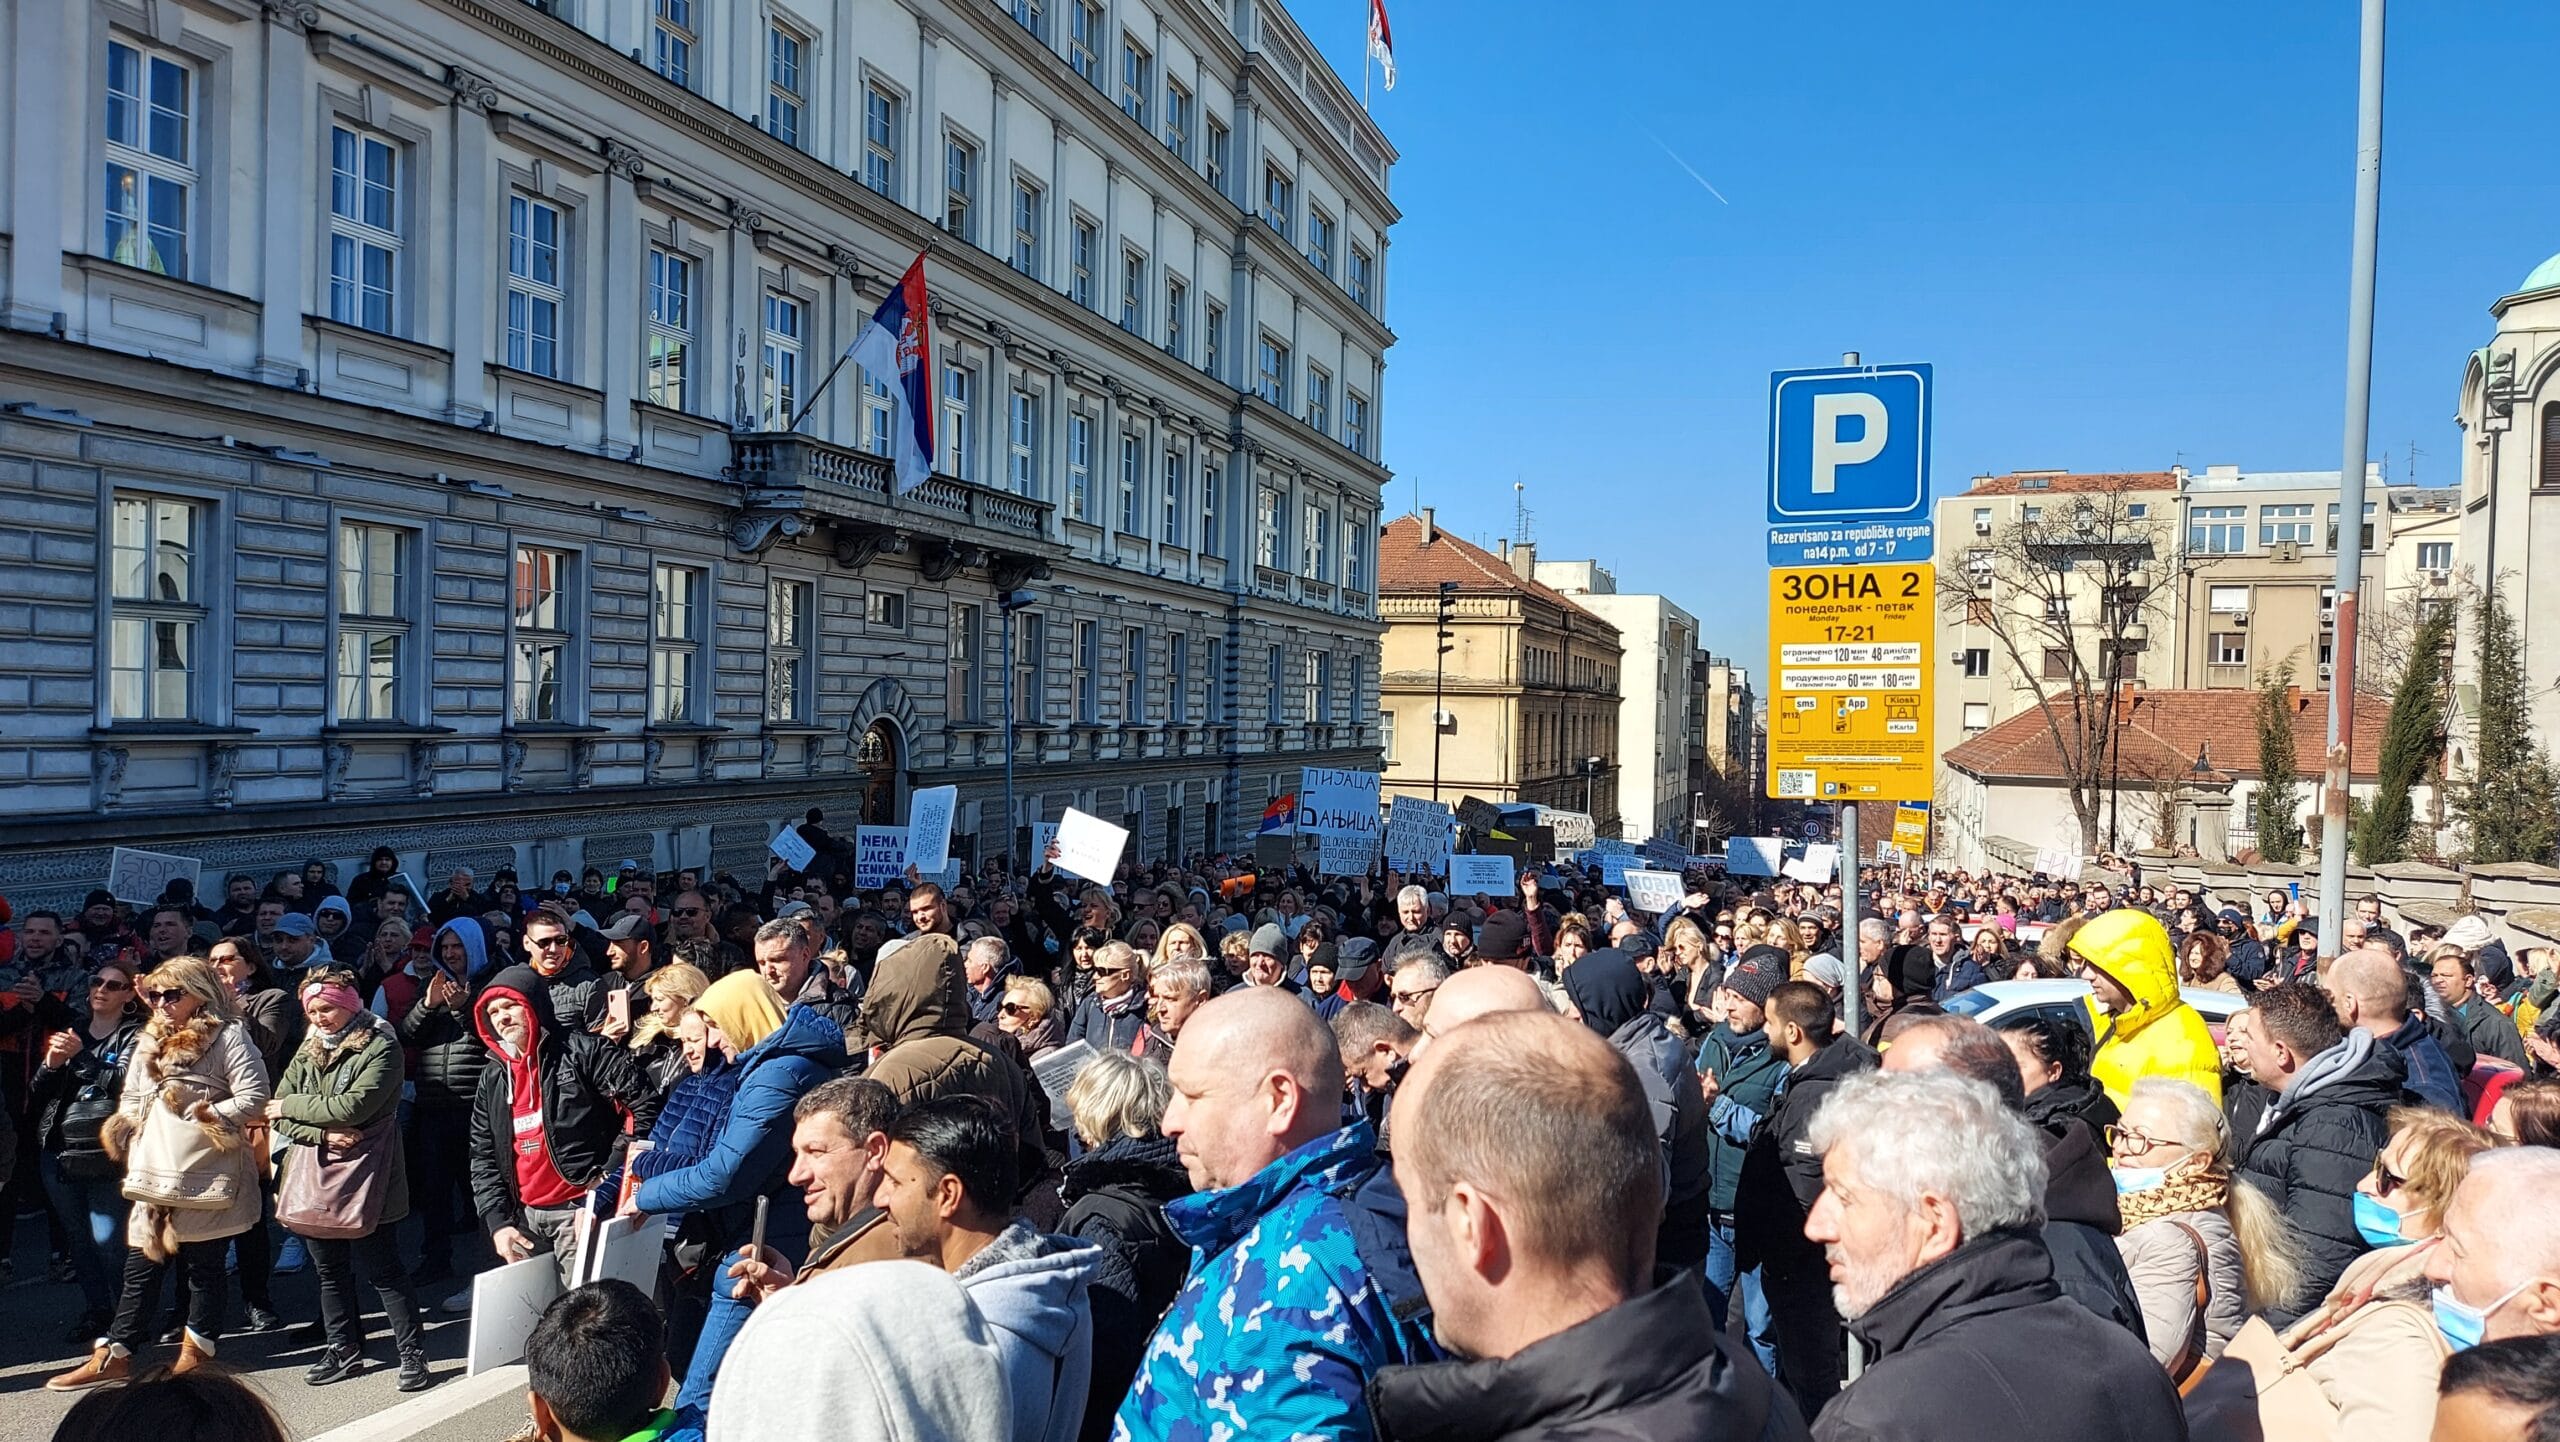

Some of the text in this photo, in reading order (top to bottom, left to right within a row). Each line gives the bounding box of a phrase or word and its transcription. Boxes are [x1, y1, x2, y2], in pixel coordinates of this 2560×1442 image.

[1811, 392, 1889, 494] P
[1771, 525, 1930, 544] Rezervisano za republičke organe
[1830, 547, 1850, 561] p.m.
[1855, 542, 1868, 557] od
[1869, 542, 1877, 556] 7
[1885, 541, 1897, 555] 17
[1782, 572, 1920, 601] ЗОНА 2
[1786, 604, 1863, 615] понедељак
[1875, 603, 1914, 613] петак
[1809, 614, 1840, 622] Monday
[1884, 613, 1906, 621] Friday
[1824, 625, 1875, 641] 17-21
[1783, 649, 1833, 657] ограничено
[1834, 647, 1850, 662] 120
[1871, 647, 1882, 661] 48
[1883, 647, 1917, 655] дин/сат
[1786, 675, 1835, 683] продужено
[1847, 673, 1859, 688] 60
[1881, 673, 1897, 688] 180
[1797, 700, 1815, 708] sms
[1848, 698, 1866, 709] App
[1890, 696, 1915, 704] Kiosk
[1307, 769, 1377, 791] ПИЈАЦА
[1300, 790, 1377, 832] БАЊИЦА
[1806, 824, 1817, 834] 40
[861, 834, 898, 848] NEMA
[1425, 837, 1435, 849] ТО
[1393, 842, 1438, 862] БРАНИ
[119, 853, 176, 880] STOP
[1627, 875, 1679, 894] НОВИ
